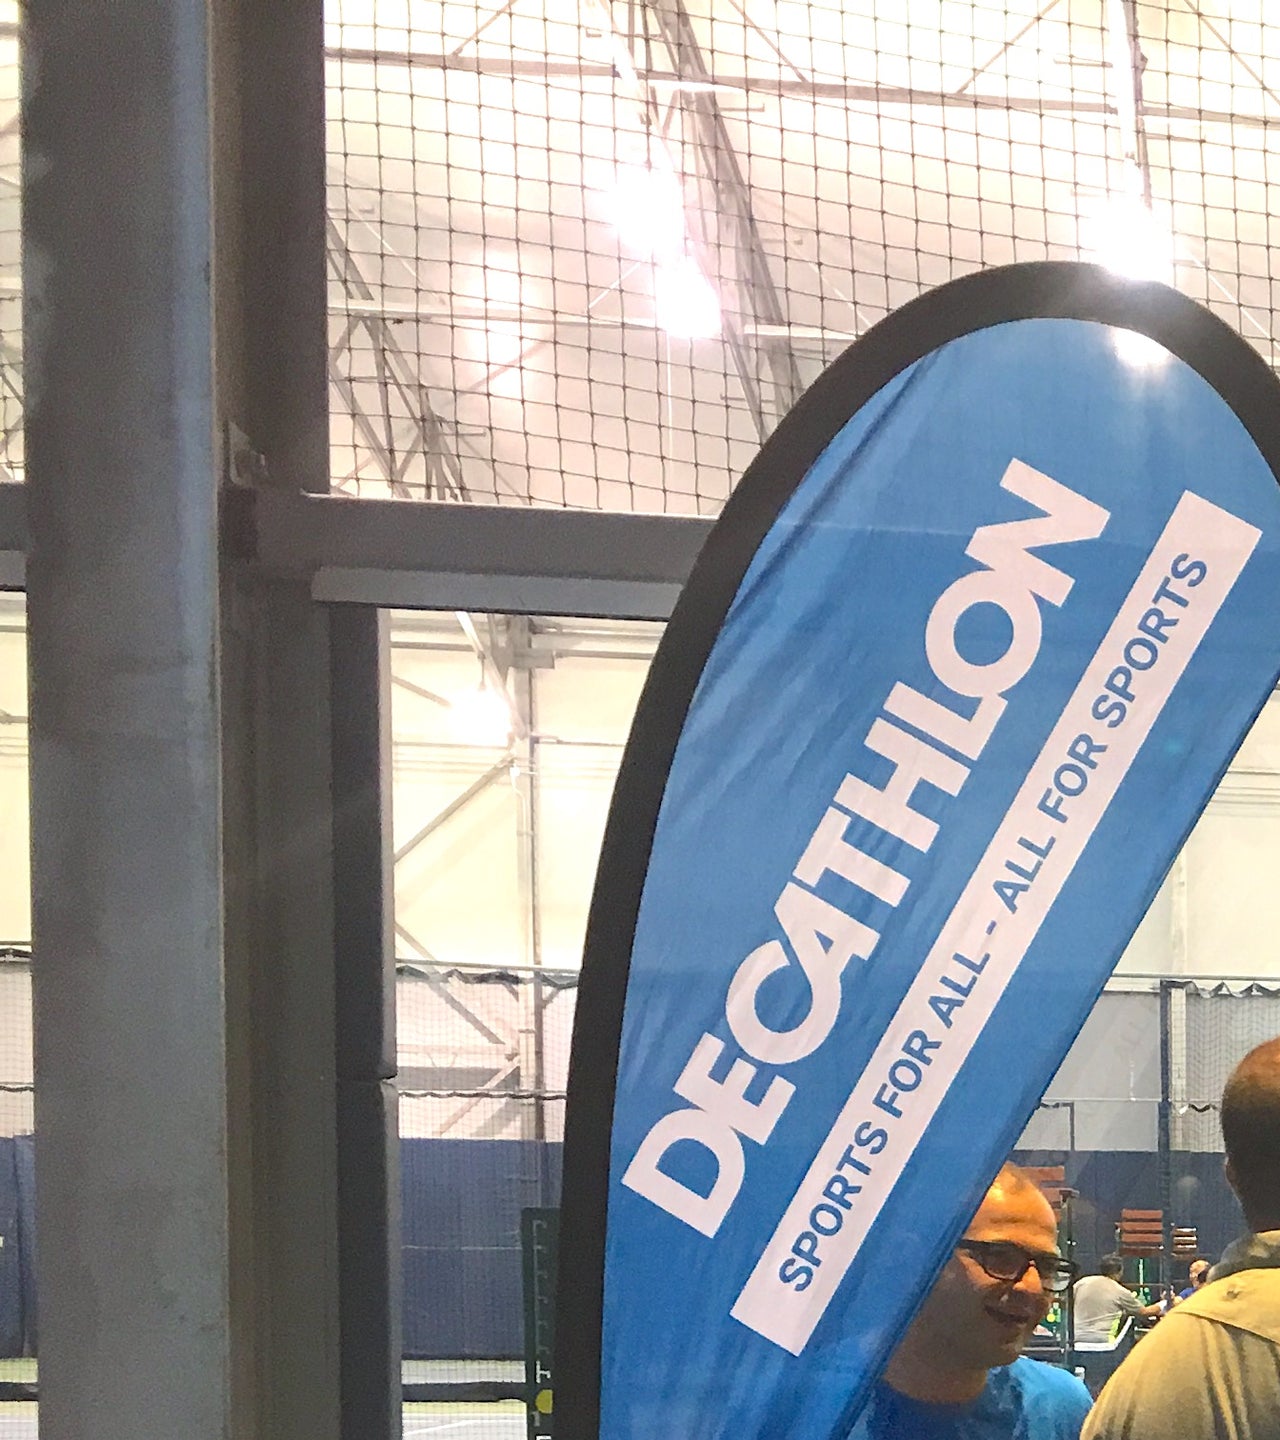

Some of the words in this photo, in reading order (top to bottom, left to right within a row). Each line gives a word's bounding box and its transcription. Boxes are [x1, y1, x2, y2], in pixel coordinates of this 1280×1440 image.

[621, 457, 1112, 1241] DECATHLON
[778, 1120, 888, 1293] SPORTS
[872, 1030, 942, 1119] FOR
[928, 953, 990, 1029] ALL
[993, 837, 1055, 914] ALL
[1037, 734, 1107, 823] FOR
[1092, 553, 1207, 728] SPORTS
